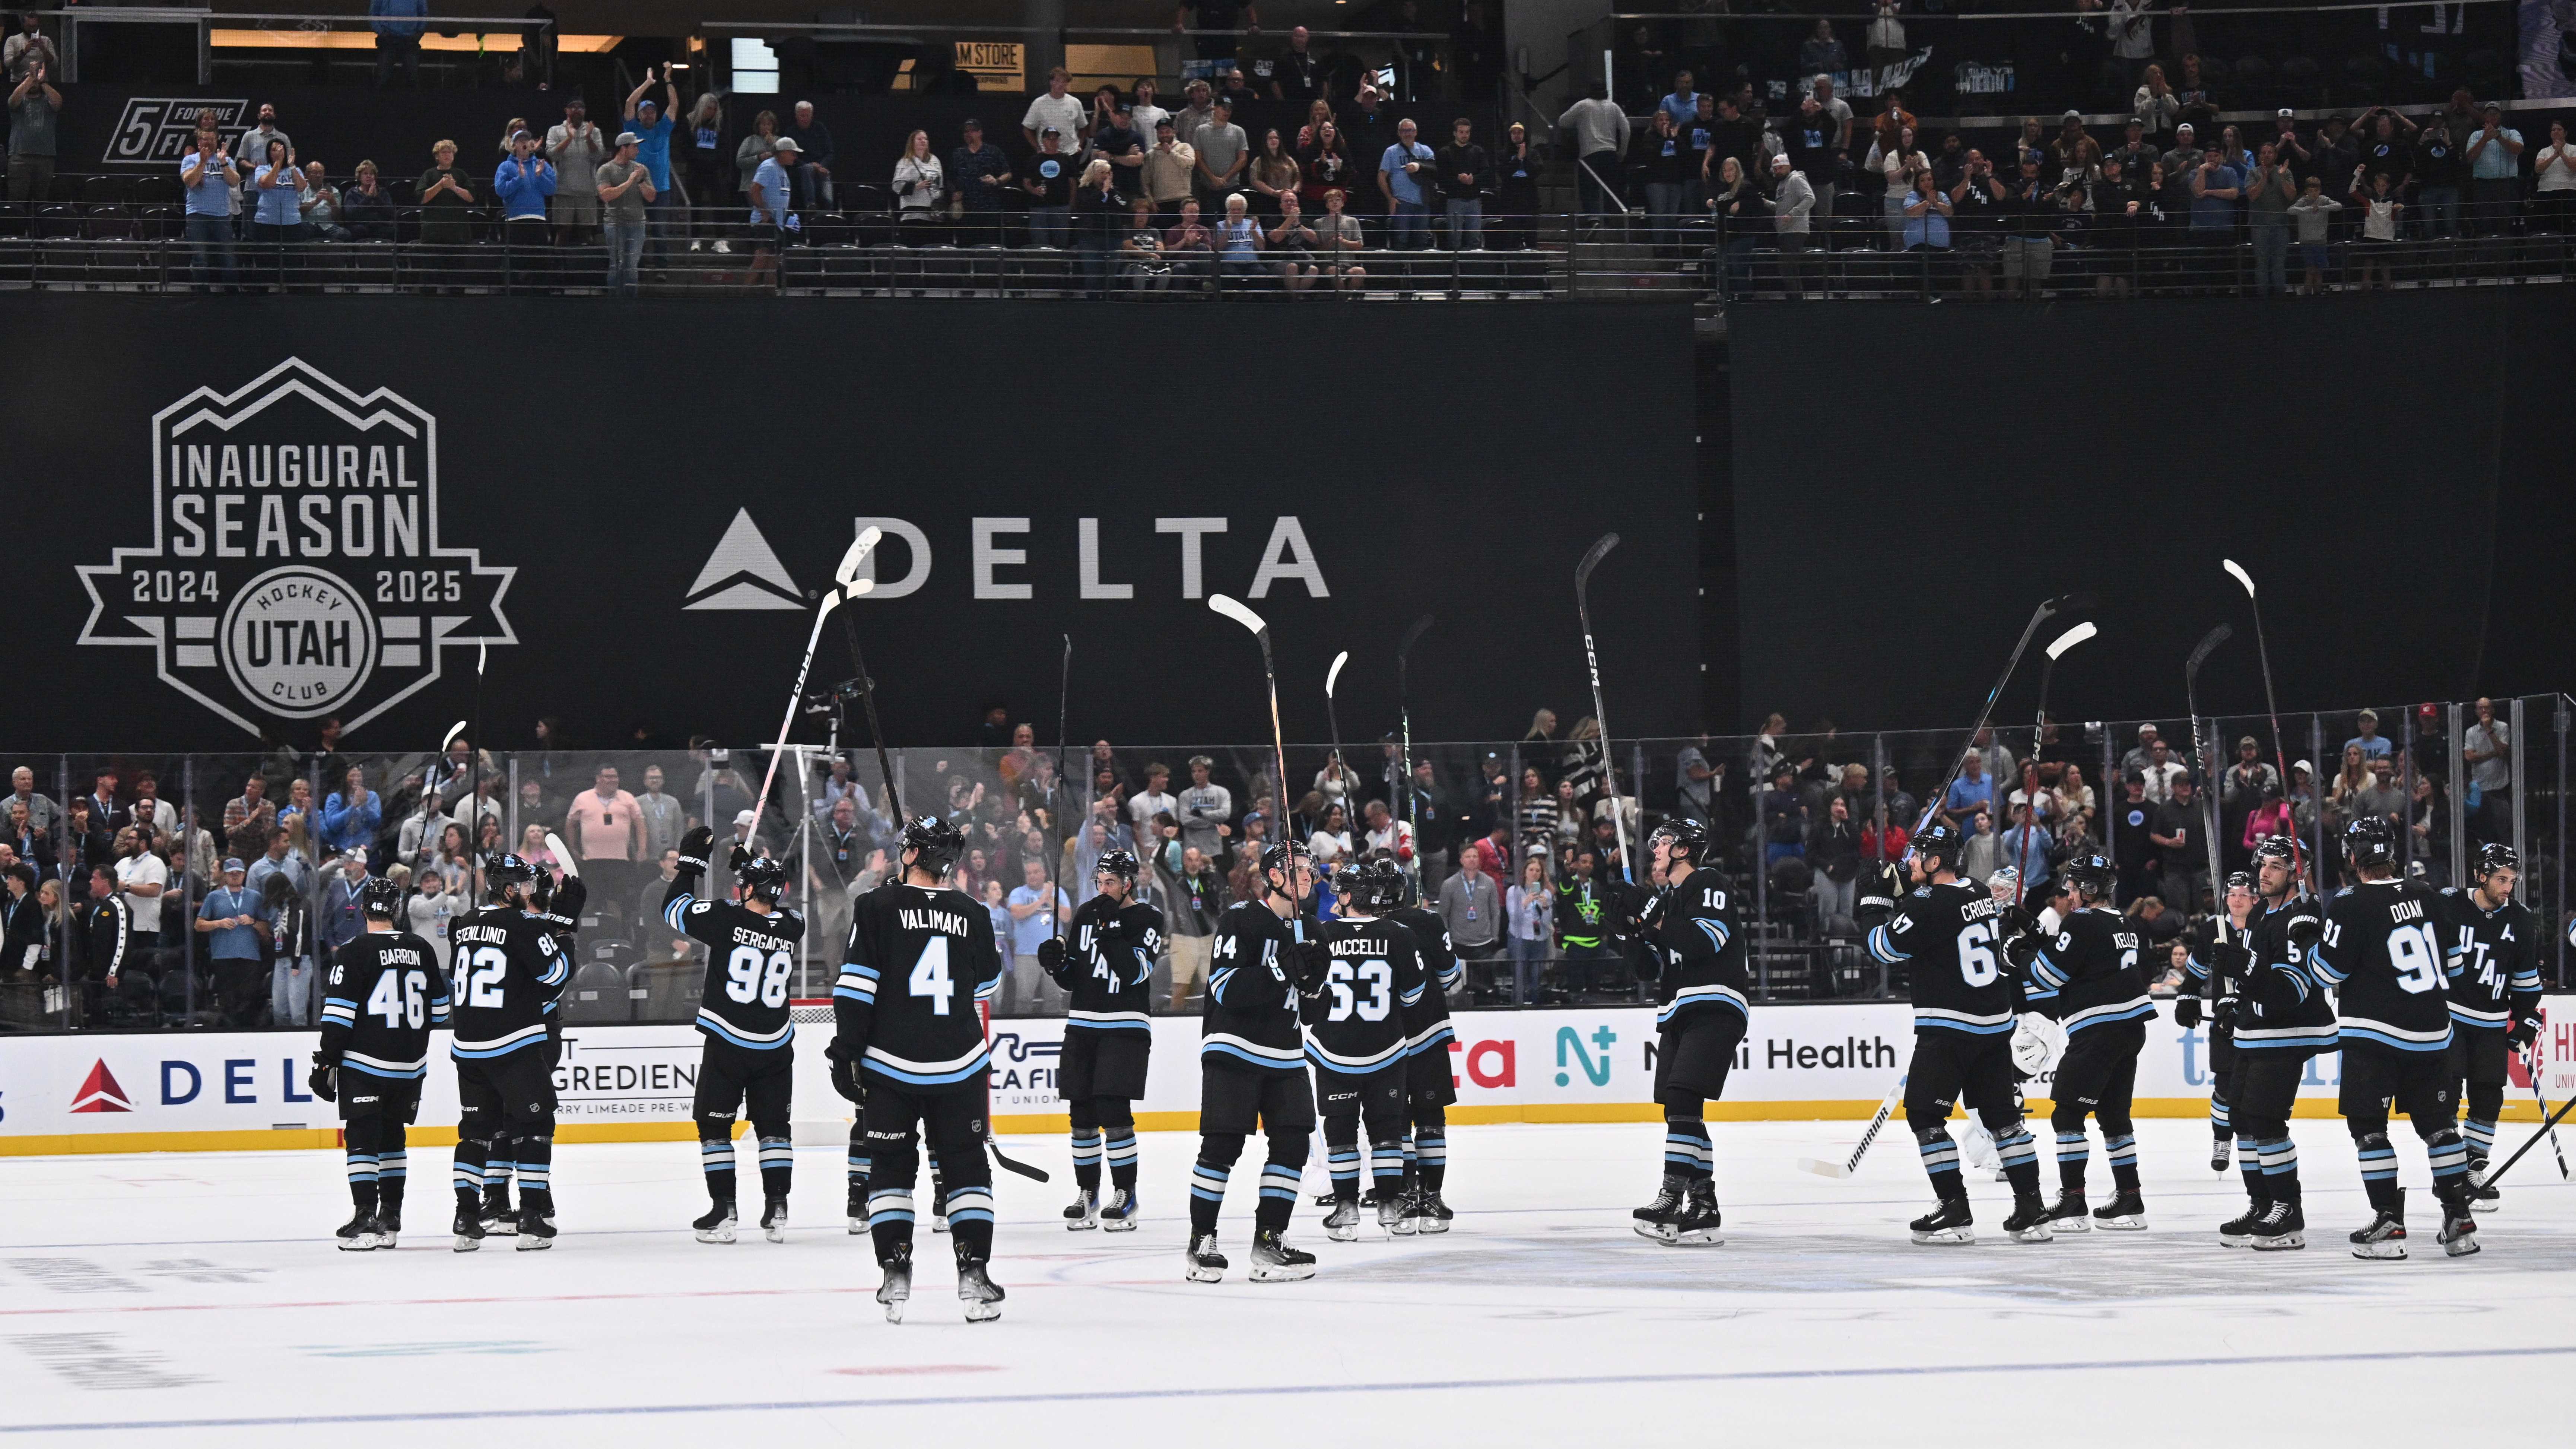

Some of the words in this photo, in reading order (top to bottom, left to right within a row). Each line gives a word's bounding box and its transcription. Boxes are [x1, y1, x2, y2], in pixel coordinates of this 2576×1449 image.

[976, 44, 1017, 65] STORE
[119, 107, 159, 156] 5
[159, 134, 237, 155] FIT
[2150, 202, 2164, 221] TAH
[1227, 230, 1251, 241] UTAH
[172, 444, 417, 487] INAUGURAL
[172, 494, 419, 557] SEASON
[854, 516, 1330, 599] DELTA
[133, 570, 219, 602] 2024
[257, 584, 341, 611] HOCKEY
[377, 570, 461, 603] 2025
[247, 619, 350, 668] UTAH
[1585, 634, 1600, 687] CCM
[273, 682, 328, 700] CLUB
[1403, 715, 1412, 777] TRUE
[2033, 710, 2045, 762] CCM
[2374, 843, 2384, 853] 91
[942, 863, 949, 873] 4
[771, 886, 782, 895] 98
[1371, 895, 1379, 904] 63
[1702, 888, 1726, 910] 10
[371, 902, 382, 911] 46
[692, 899, 712, 914] 8
[1961, 898, 1996, 922] CROUSE
[2390, 899, 2423, 923] DOAN
[547, 913, 574, 926] BAU
[899, 909, 967, 937] VALIMAKI
[456, 925, 507, 945] STENLUND
[537, 932, 559, 957] 82
[732, 926, 795, 955] SERGACHEV
[1143, 927, 1161, 954] 93
[2055, 931, 2072, 952] 9
[2112, 932, 2139, 949] KELLER
[2323, 918, 2342, 948] 91
[2500, 923, 2515, 942] A
[379, 948, 421, 966] BARRON
[1213, 934, 1237, 960] 84
[1328, 939, 1388, 957] MACCELLI
[2287, 940, 2302, 963] 5
[2386, 922, 2450, 995] 91
[2459, 925, 2506, 1000] UTAH
[329, 965, 344, 985] 46
[454, 945, 507, 1009] 82
[725, 945, 793, 1009] 98
[908, 935, 954, 1015] 4
[367, 968, 428, 1030] 46
[1327, 960, 1392, 1022] 63
[1767, 1036, 1895, 1070] Health
[2555, 1023, 2576, 1062] H
[161, 1058, 312, 1105] DEL
[553, 1064, 696, 1091] GREDIEN
[1030, 1068, 1059, 1089] FI
[2556, 1074, 2575, 1088] UNIV
[1012, 1096, 1060, 1104] UNION
[1328, 1091, 1358, 1101] CCM
[1935, 1098, 1955, 1108] BAU
[587, 1103, 645, 1114] LIMEADE
[867, 1131, 906, 1140] BAUER
[1847, 1106, 1889, 1173] WARRIOR
